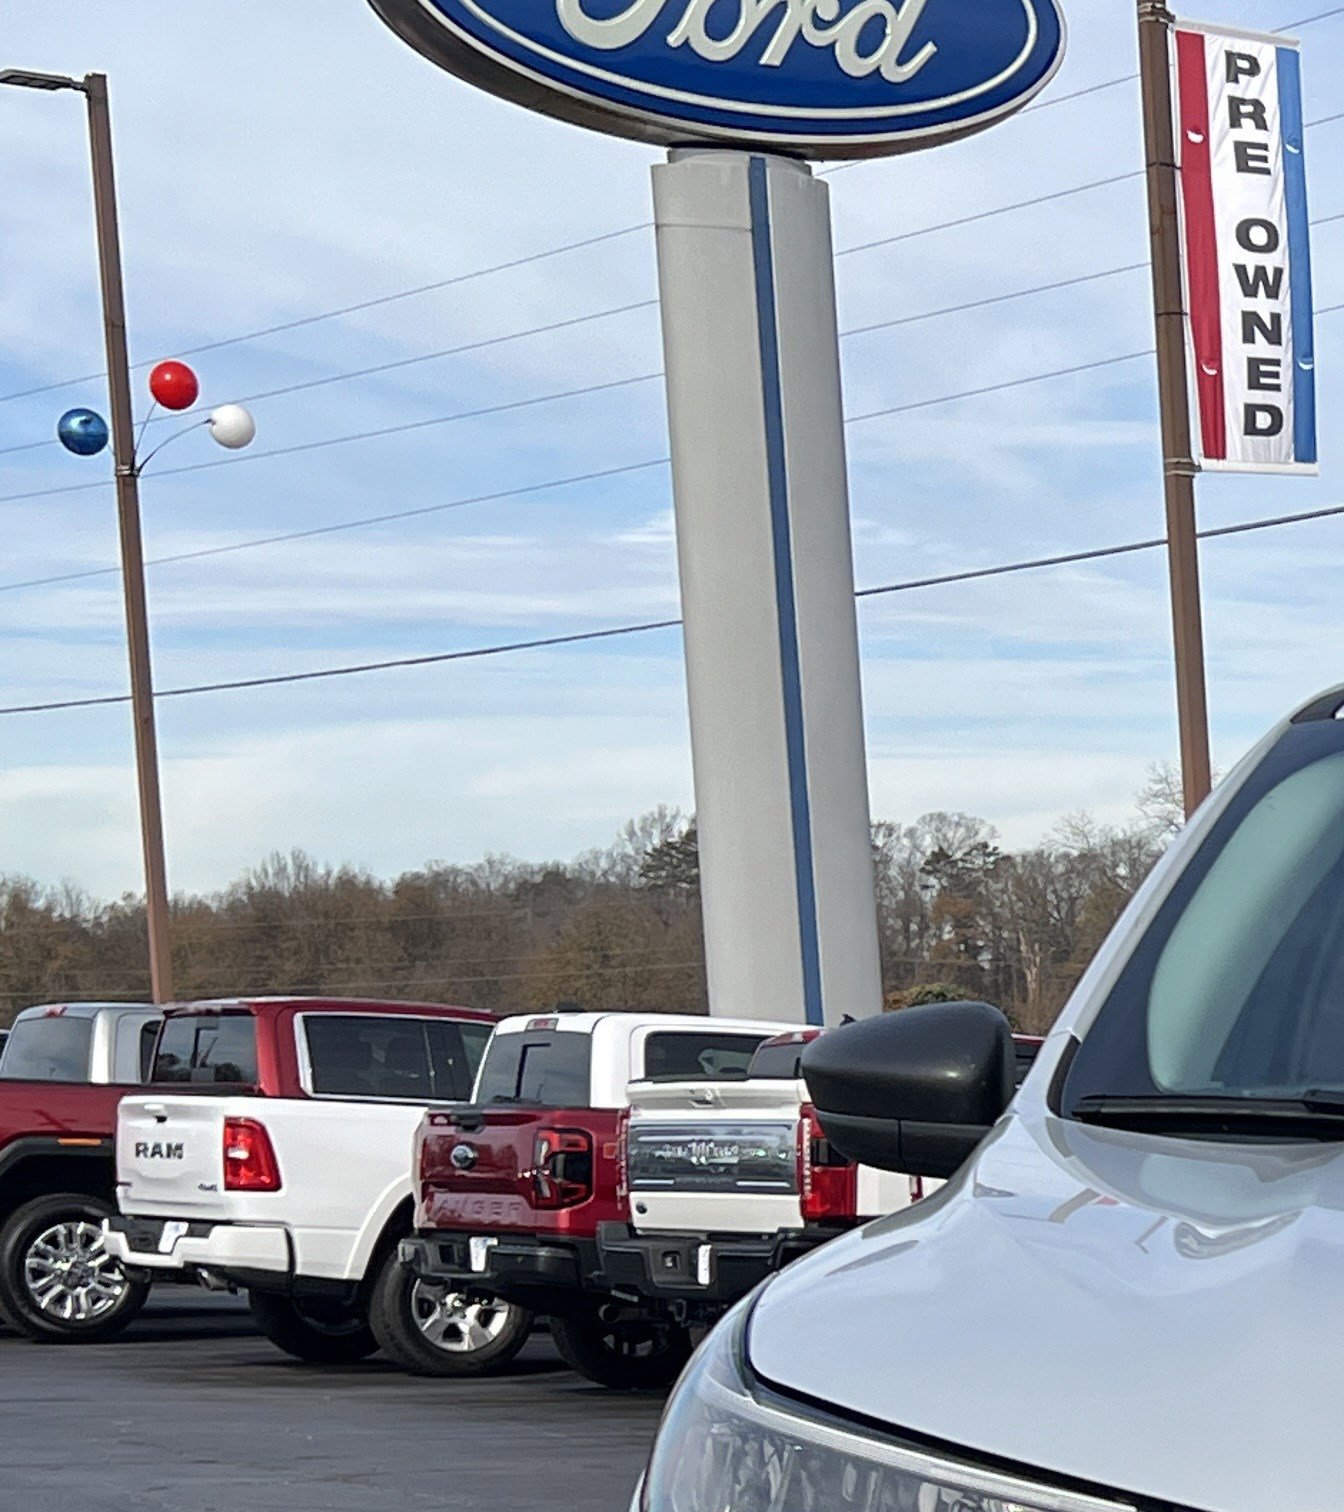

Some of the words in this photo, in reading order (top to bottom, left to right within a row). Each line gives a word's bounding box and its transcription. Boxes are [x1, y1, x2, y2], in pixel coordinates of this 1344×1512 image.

[1224, 48, 1272, 176] PRE
[1231, 217, 1285, 438] OWNED
[135, 1142, 184, 1160] RAM
